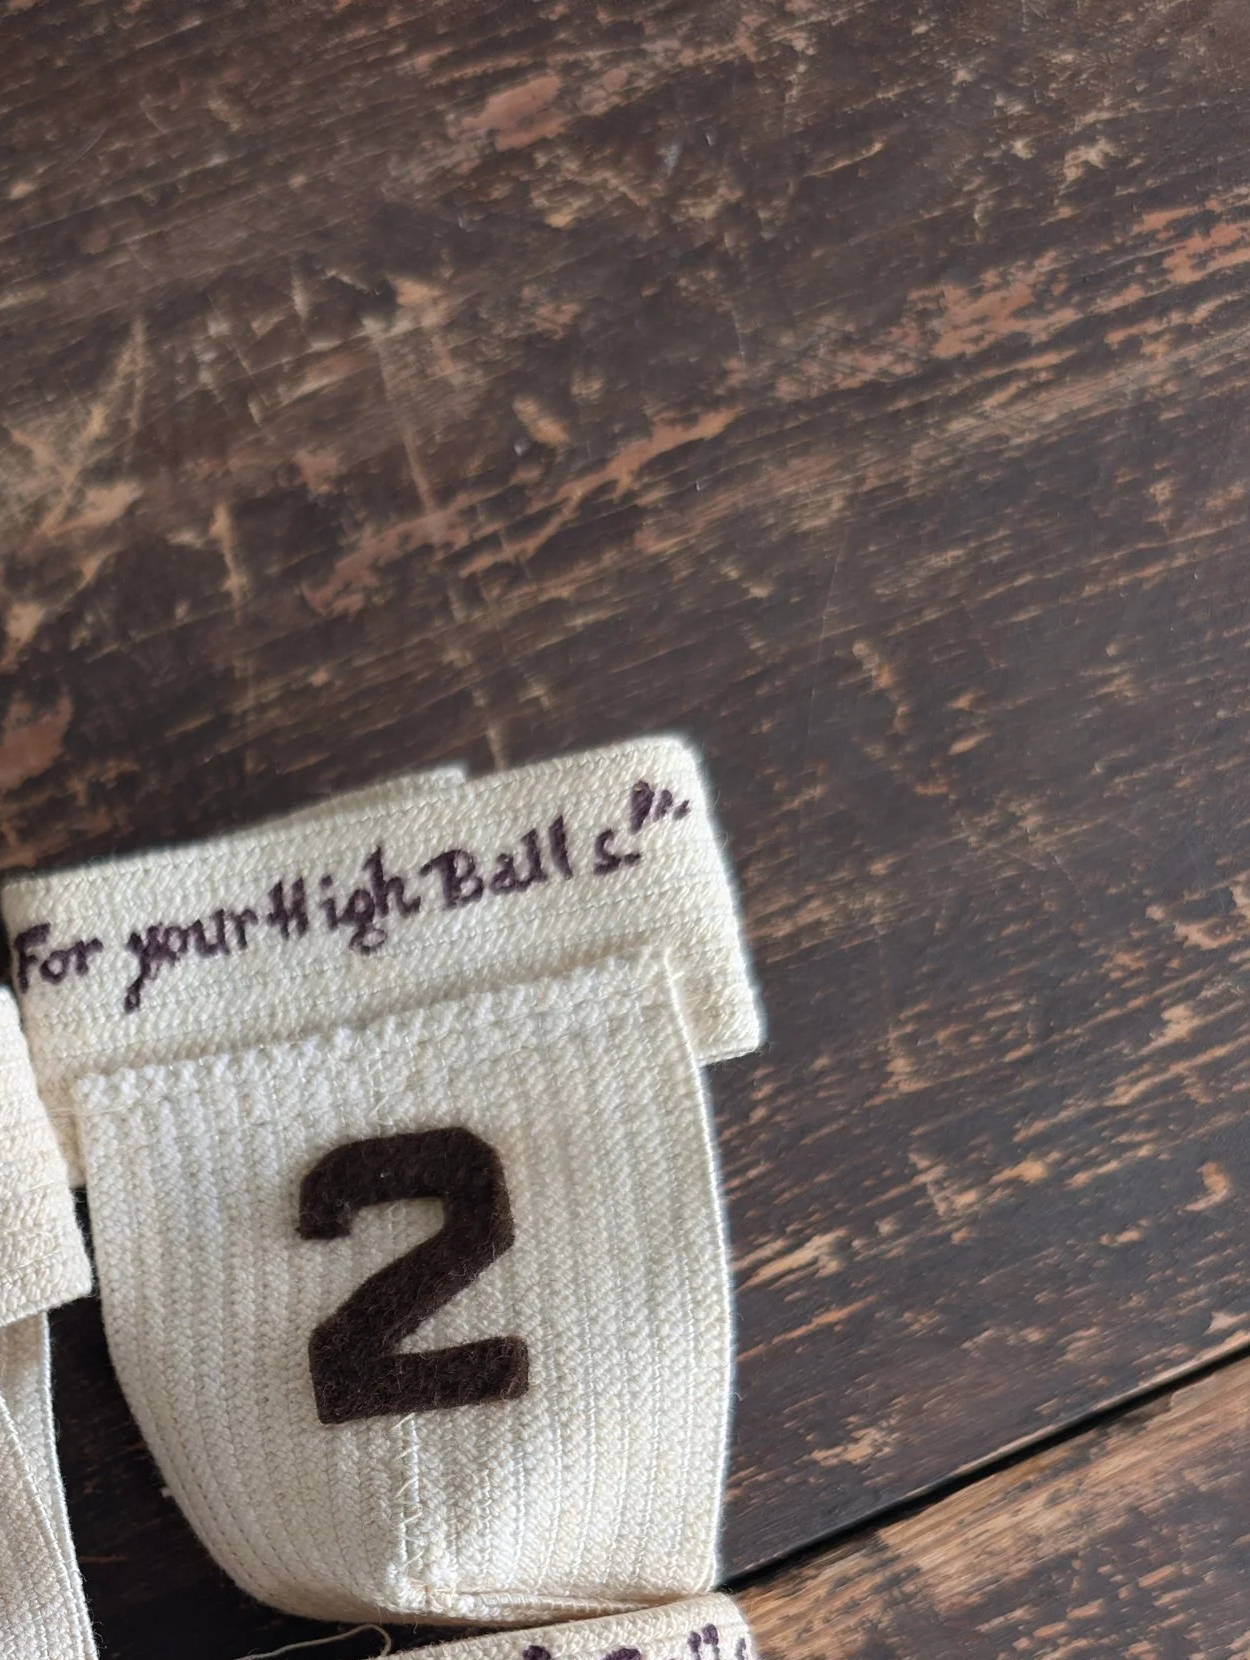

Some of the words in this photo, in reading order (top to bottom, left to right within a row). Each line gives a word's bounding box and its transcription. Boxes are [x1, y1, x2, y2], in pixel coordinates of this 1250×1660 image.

[123, 908, 258, 1014] your
[265, 844, 421, 955] High
[297, 1125, 530, 1424] 2
